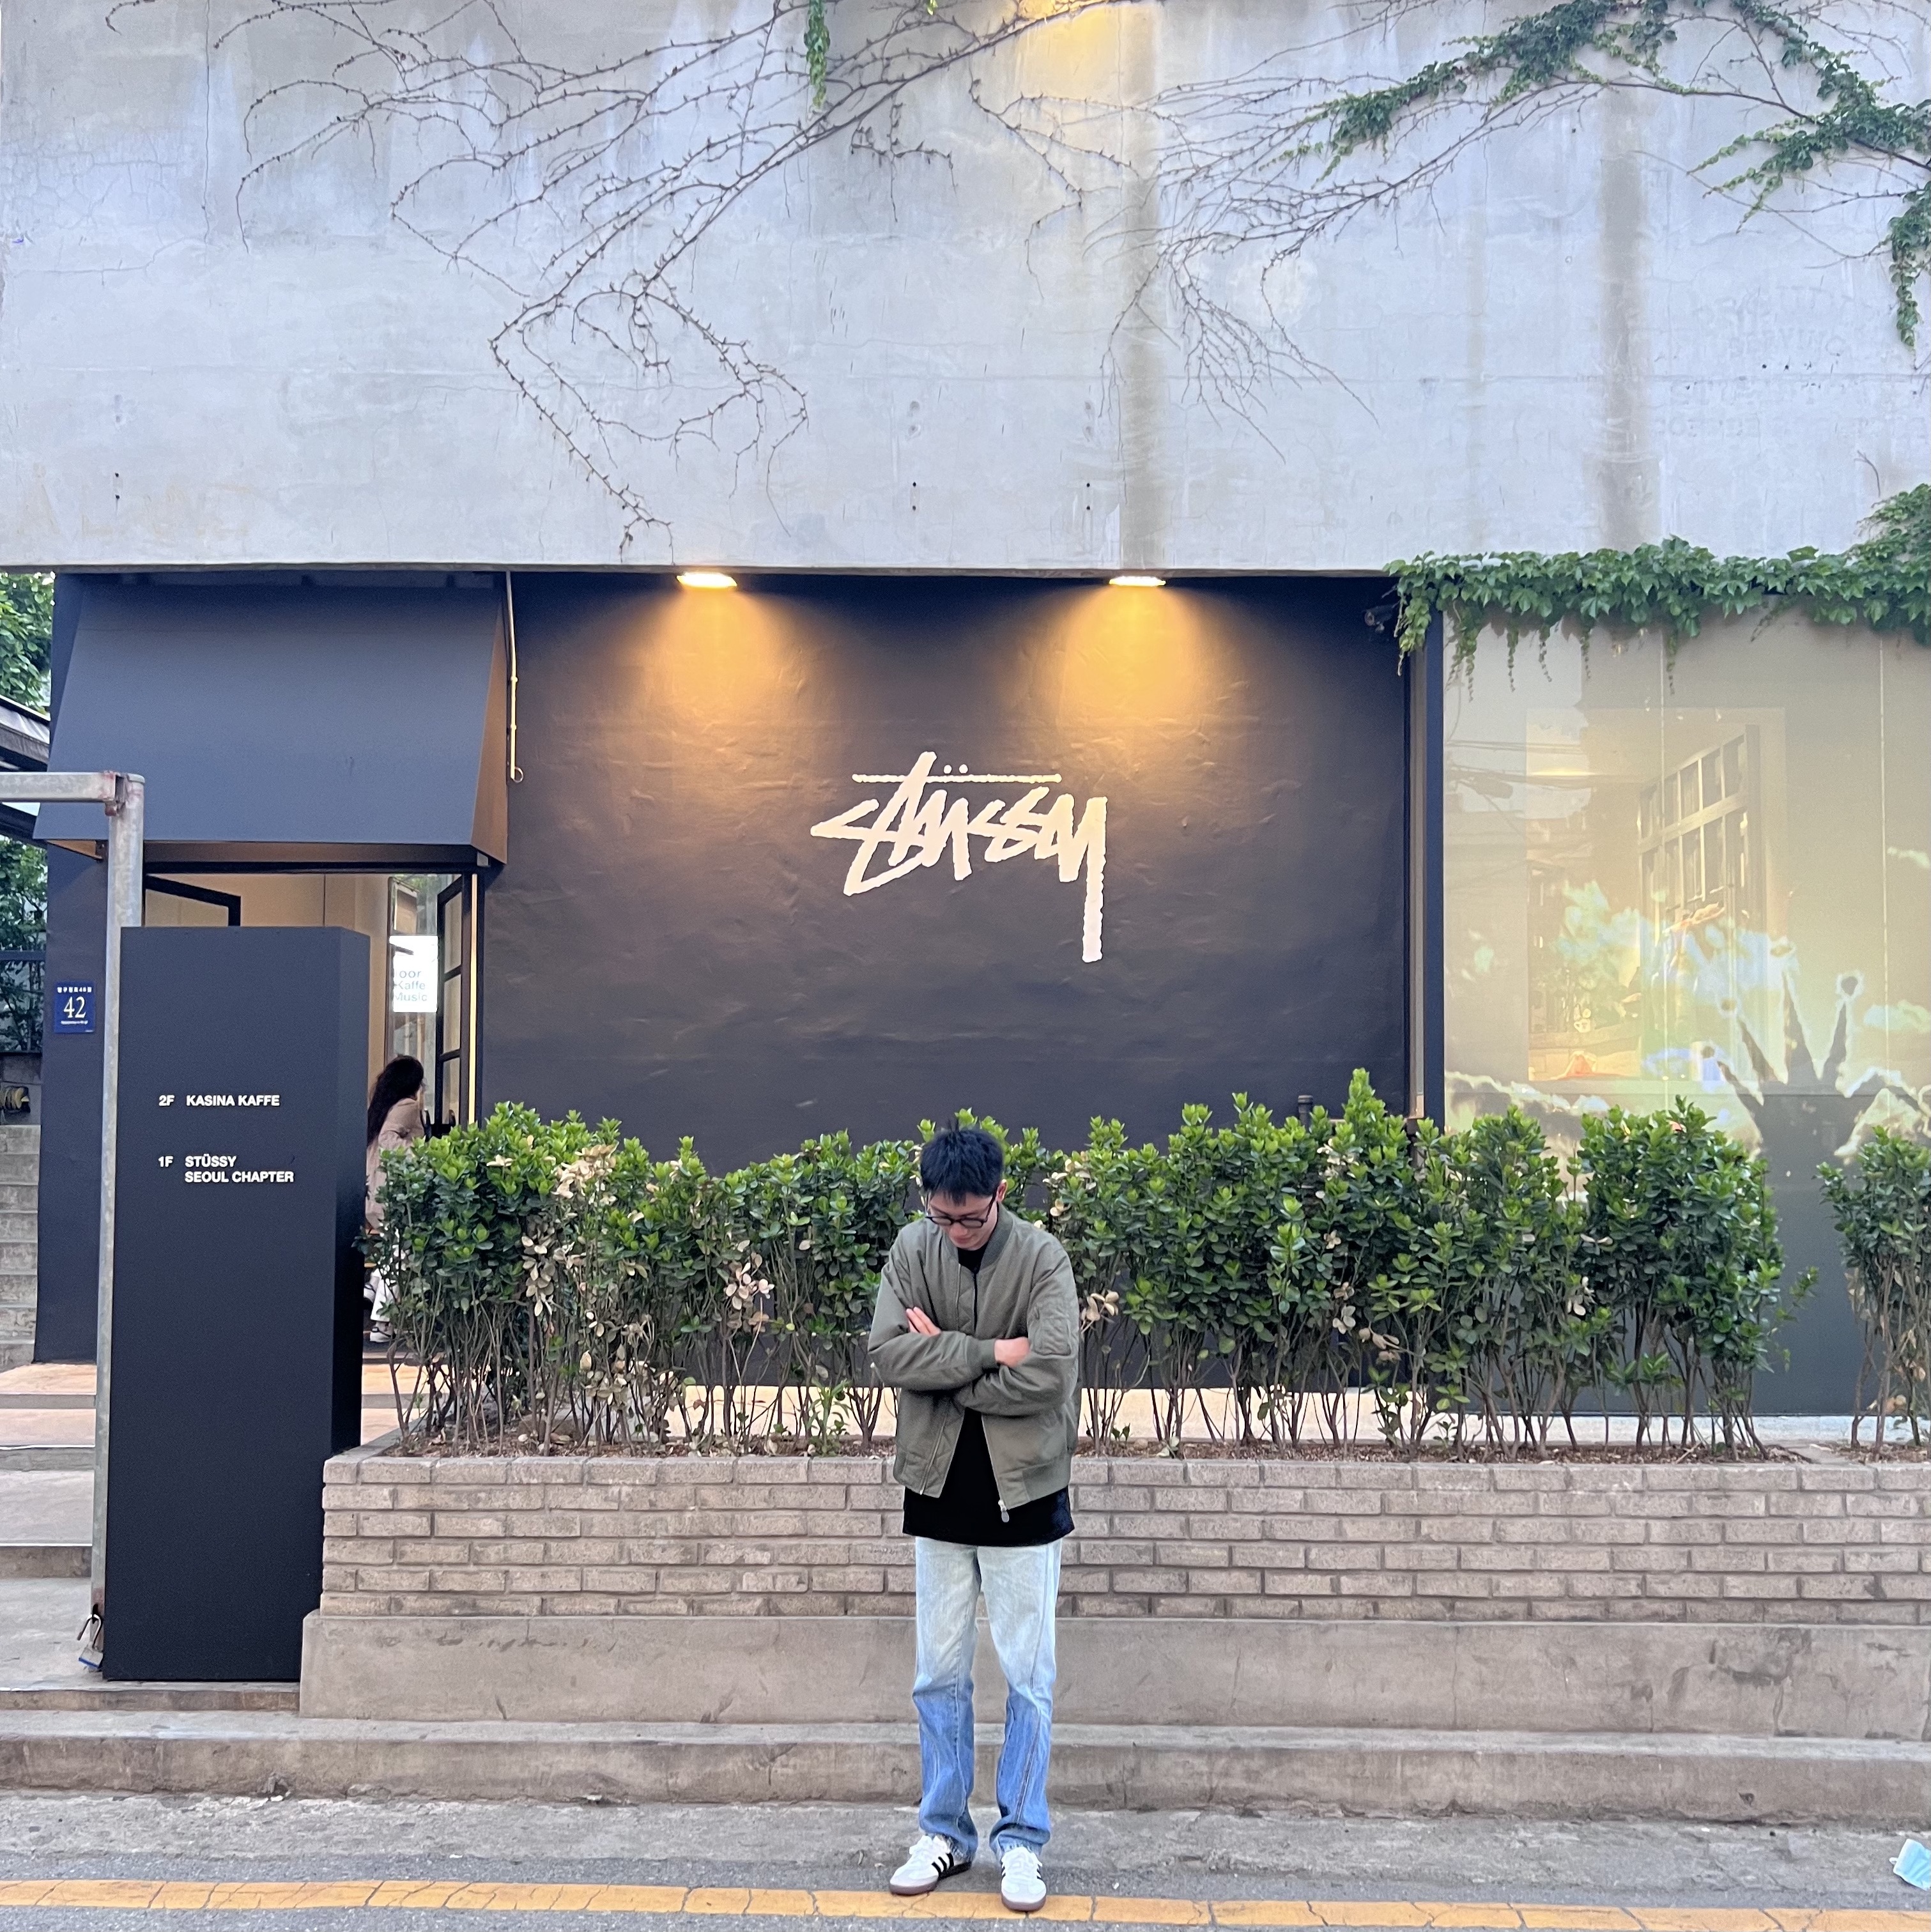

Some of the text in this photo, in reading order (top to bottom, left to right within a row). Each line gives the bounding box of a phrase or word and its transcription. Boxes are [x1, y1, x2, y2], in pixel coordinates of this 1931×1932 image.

[63, 996, 86, 1018] 42
[158, 1094, 281, 1107] 2F KASINA KAFFE
[158, 1153, 237, 1167] 1F STÜSSY
[185, 1170, 295, 1183] SEOUL CHAPTER
